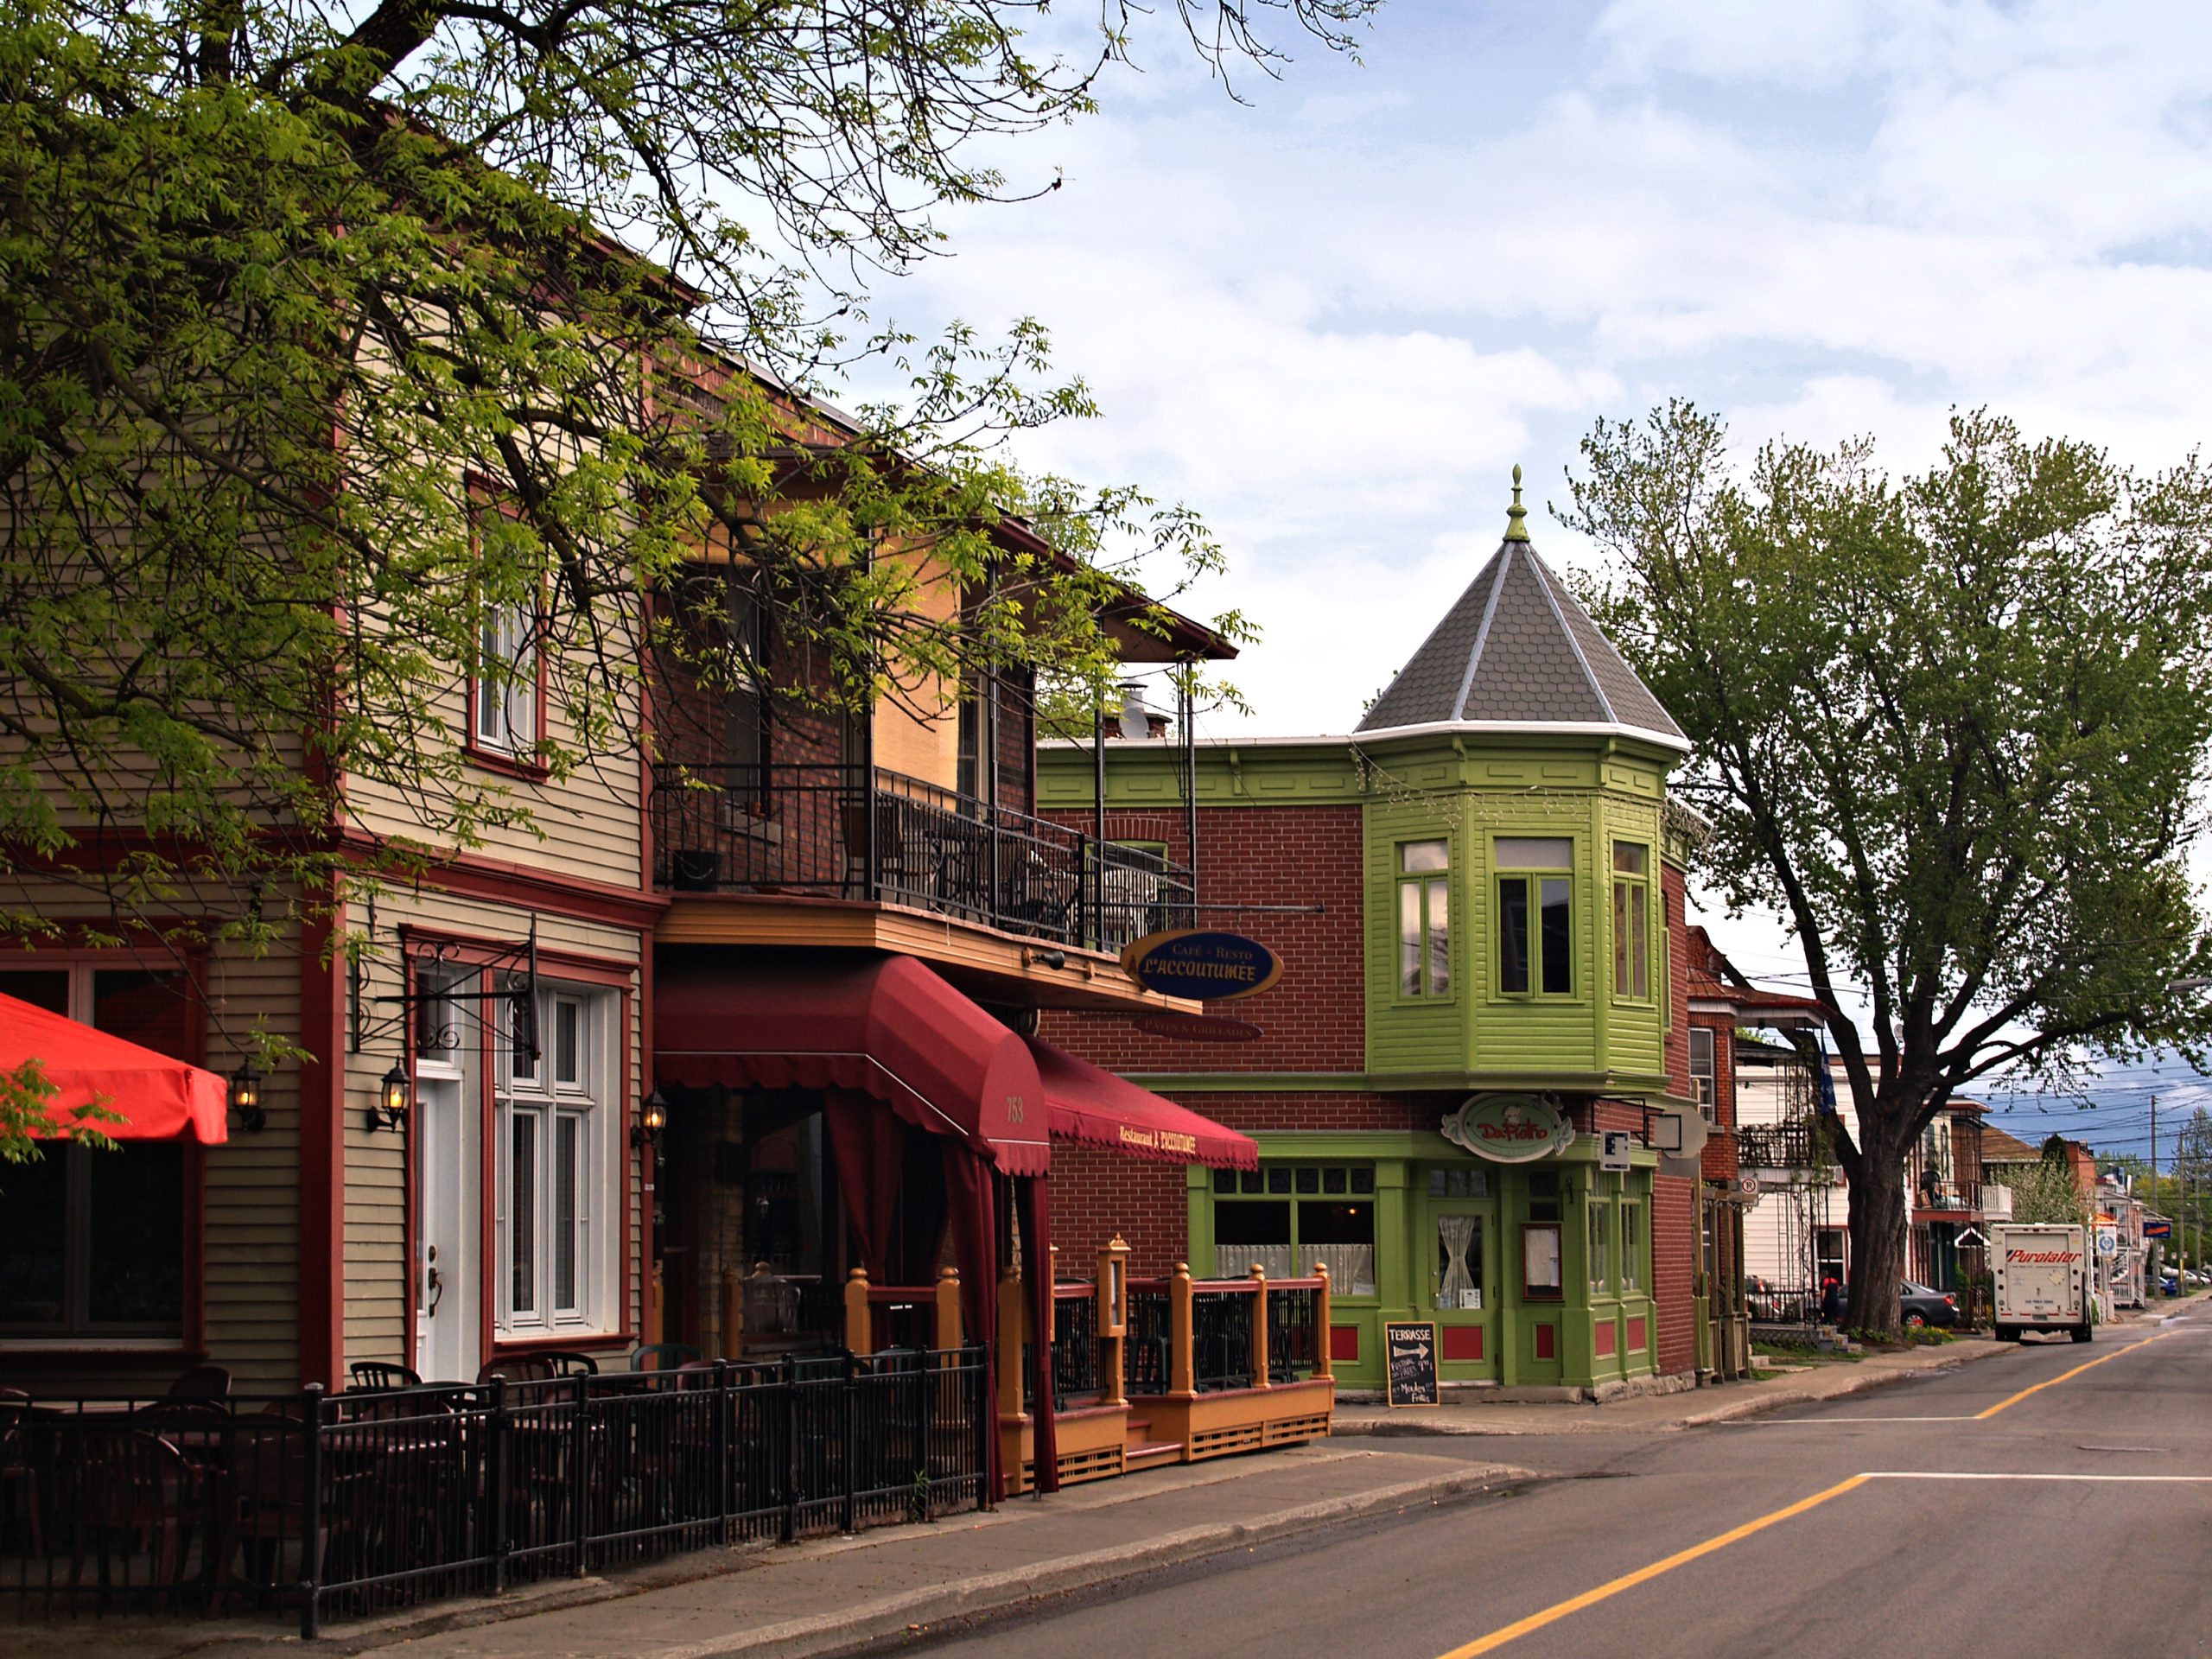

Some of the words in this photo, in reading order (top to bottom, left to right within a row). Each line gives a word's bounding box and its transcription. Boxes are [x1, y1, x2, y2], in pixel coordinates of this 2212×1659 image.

[1216, 946, 1253, 960] RESTO
[1007, 1096, 1024, 1123] 753
[1120, 1126, 1153, 1146] Restaurant
[2006, 1249, 2082, 1263] Purolator
[1389, 1329, 1432, 1341] TERRASSE
